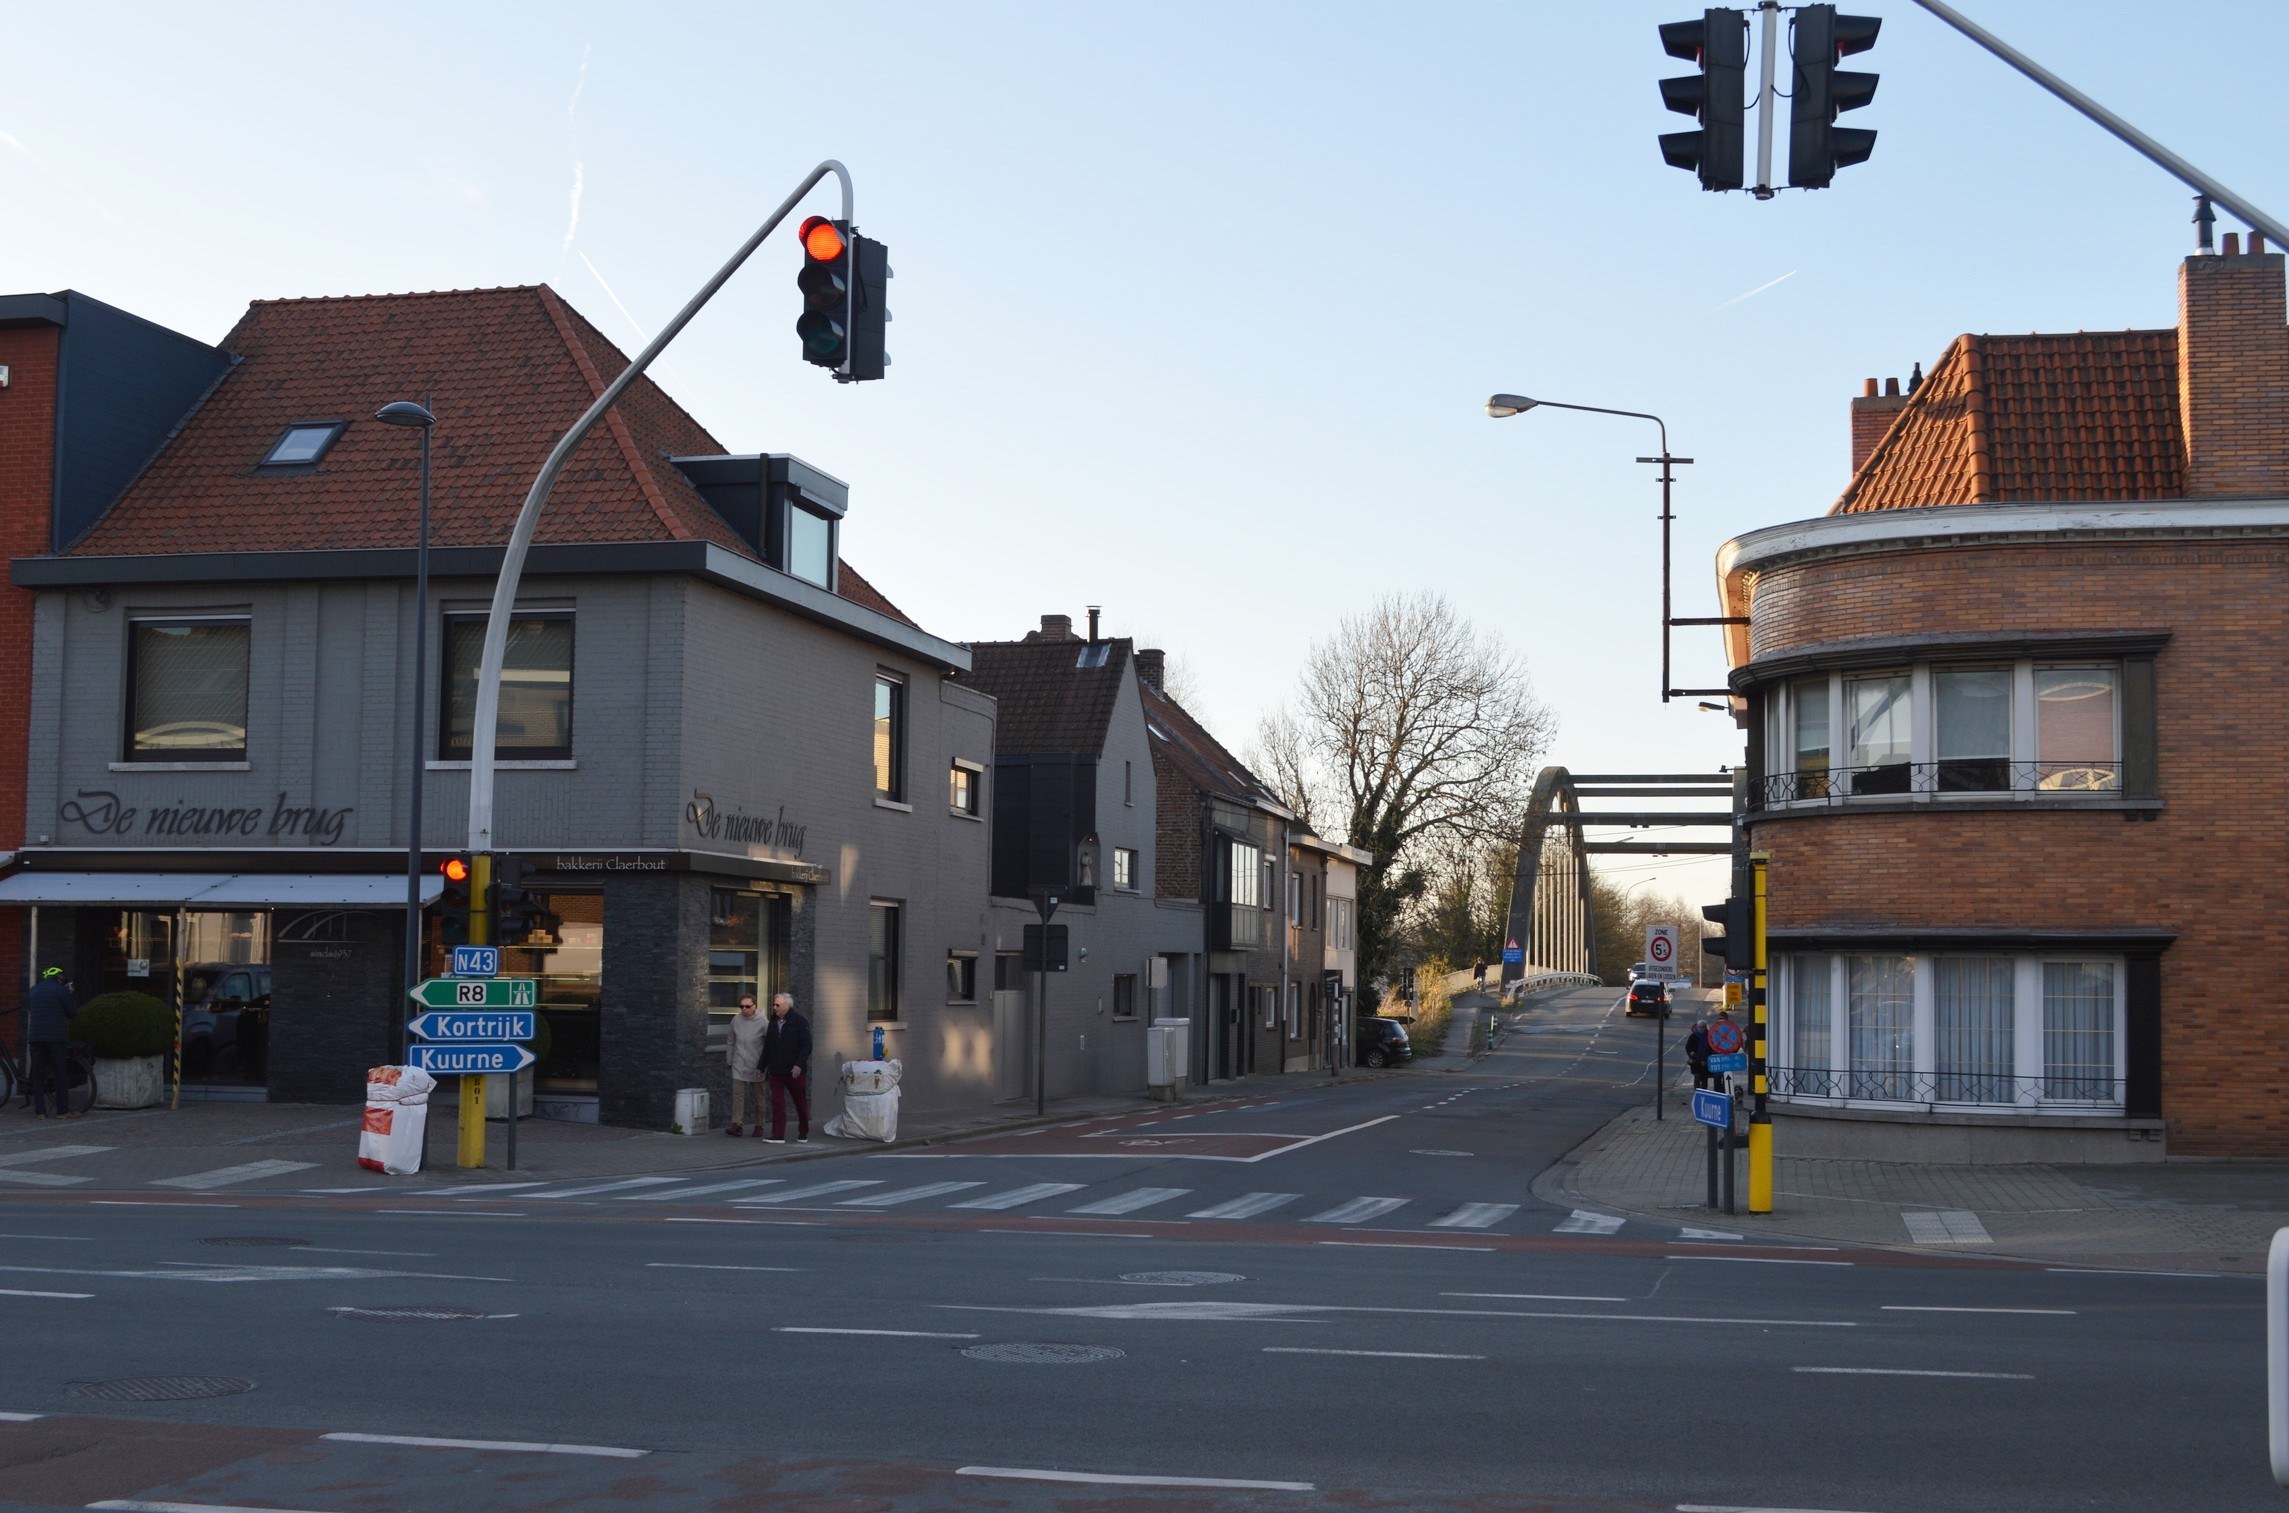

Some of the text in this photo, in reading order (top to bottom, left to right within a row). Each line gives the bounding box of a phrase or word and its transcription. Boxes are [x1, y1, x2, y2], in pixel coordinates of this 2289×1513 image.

[60, 788, 354, 846] De nieuwe brug
[686, 788, 807, 859] De nieuwe brug
[605, 856, 666, 870] Claerbout
[457, 951, 494, 972] N43
[459, 985, 484, 1002] R8
[437, 1016, 525, 1041] Kortrijk
[421, 1049, 504, 1069] Kuurne
